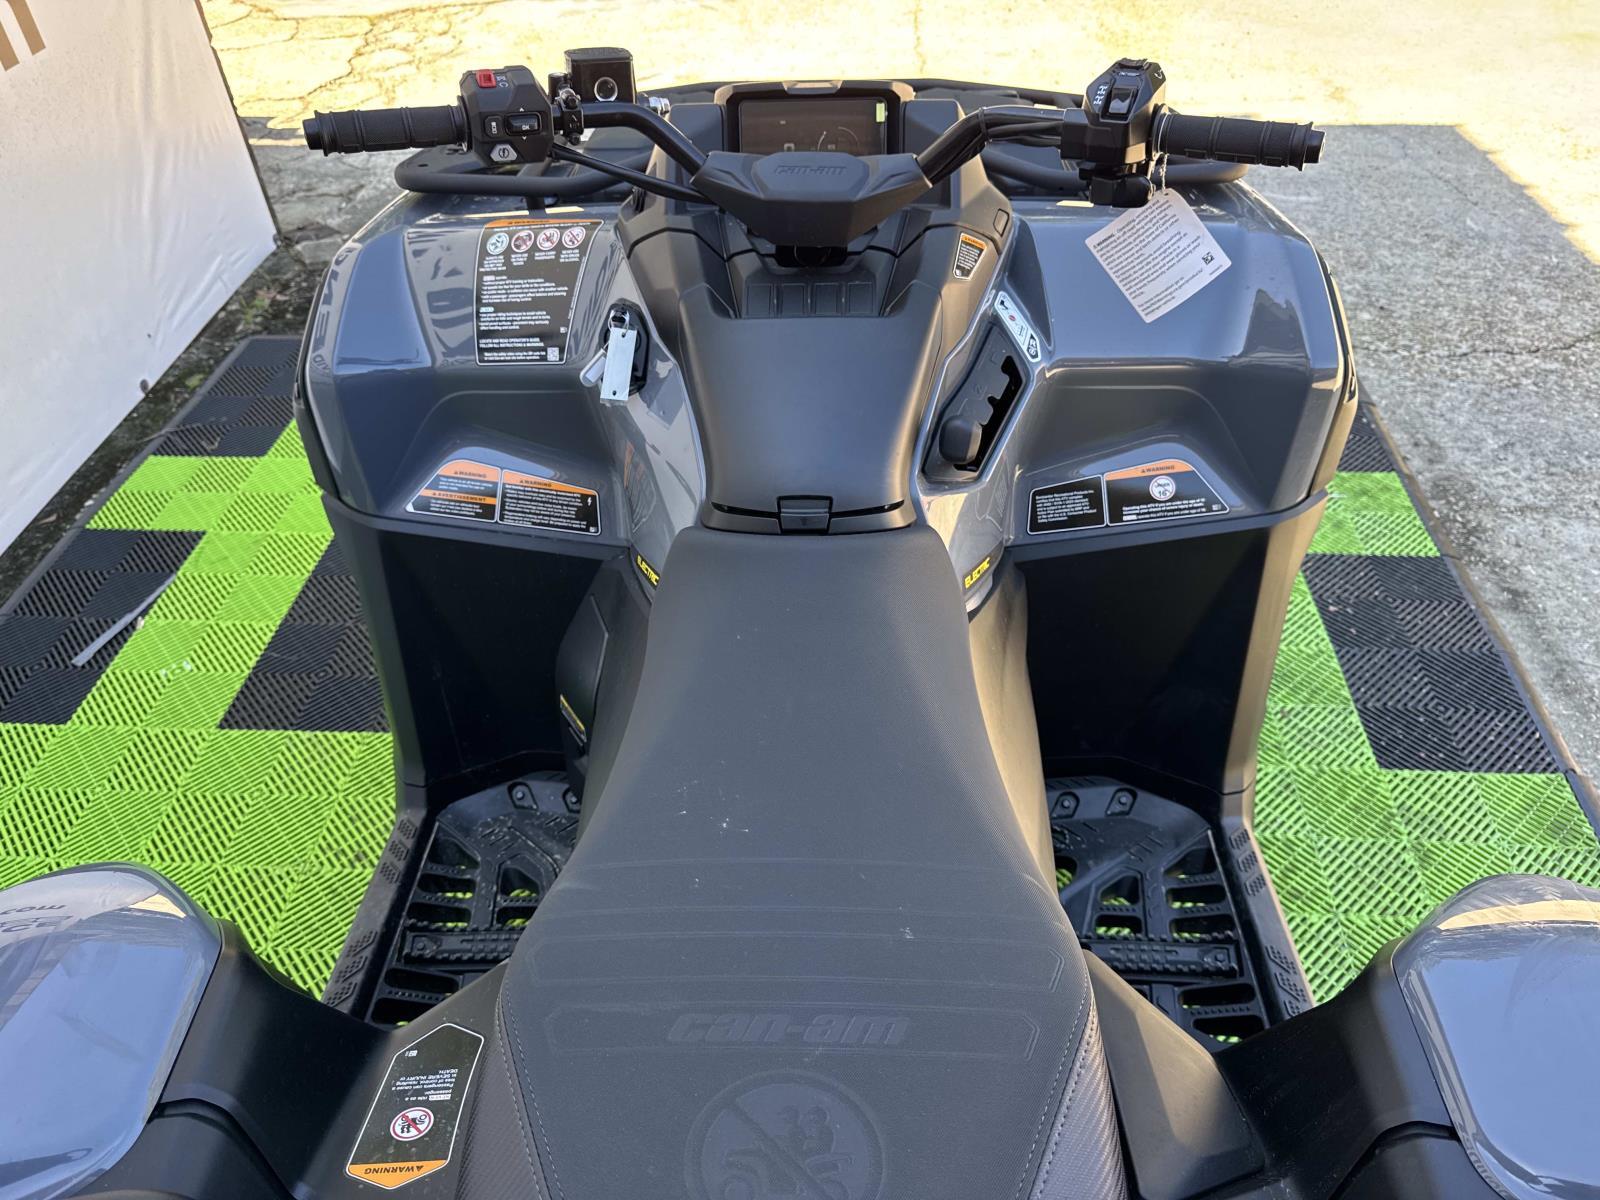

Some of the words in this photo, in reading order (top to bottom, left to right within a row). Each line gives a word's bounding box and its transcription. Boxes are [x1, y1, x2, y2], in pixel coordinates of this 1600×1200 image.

[637, 555, 660, 586] ELECTRIC
[964, 557, 990, 588] ELECTRIC
[364, 1166, 414, 1174] WARNING
